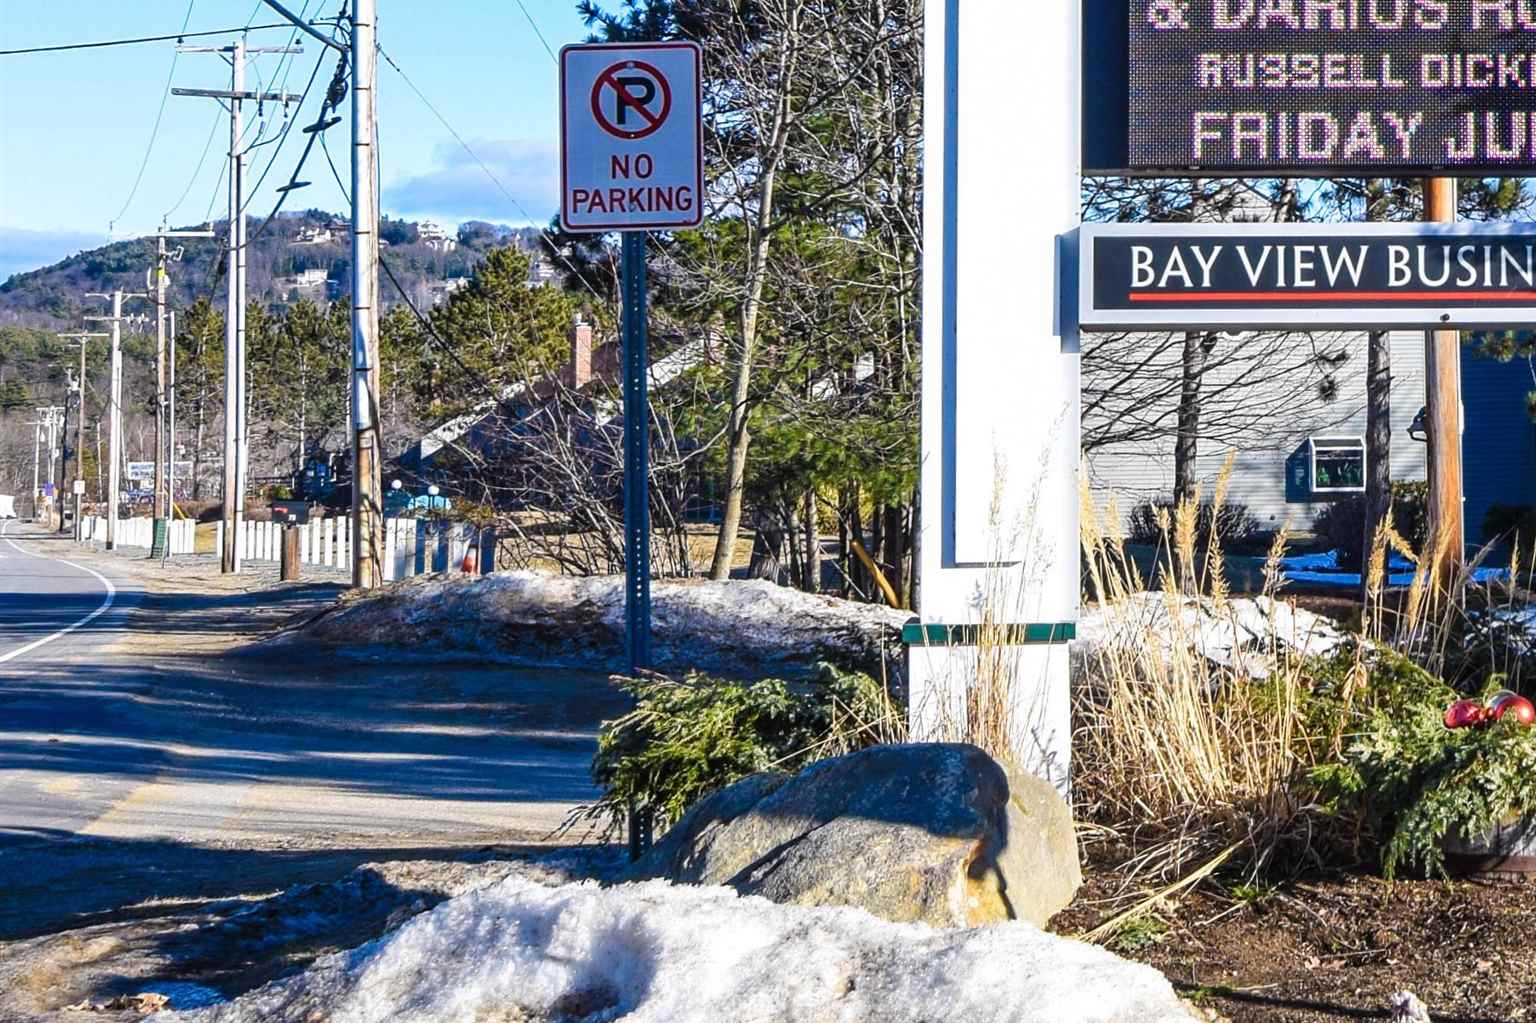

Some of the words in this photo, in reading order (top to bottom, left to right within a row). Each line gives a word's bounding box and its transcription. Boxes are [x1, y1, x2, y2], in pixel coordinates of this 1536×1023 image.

[1197, 52, 1405, 89] RUSSELL
[1192, 110, 1424, 161] FRIDAY
[611, 153, 654, 180] NO
[572, 185, 693, 214] PARKING
[1130, 245, 1223, 288] BAY
[1235, 245, 1370, 288] VIEW
